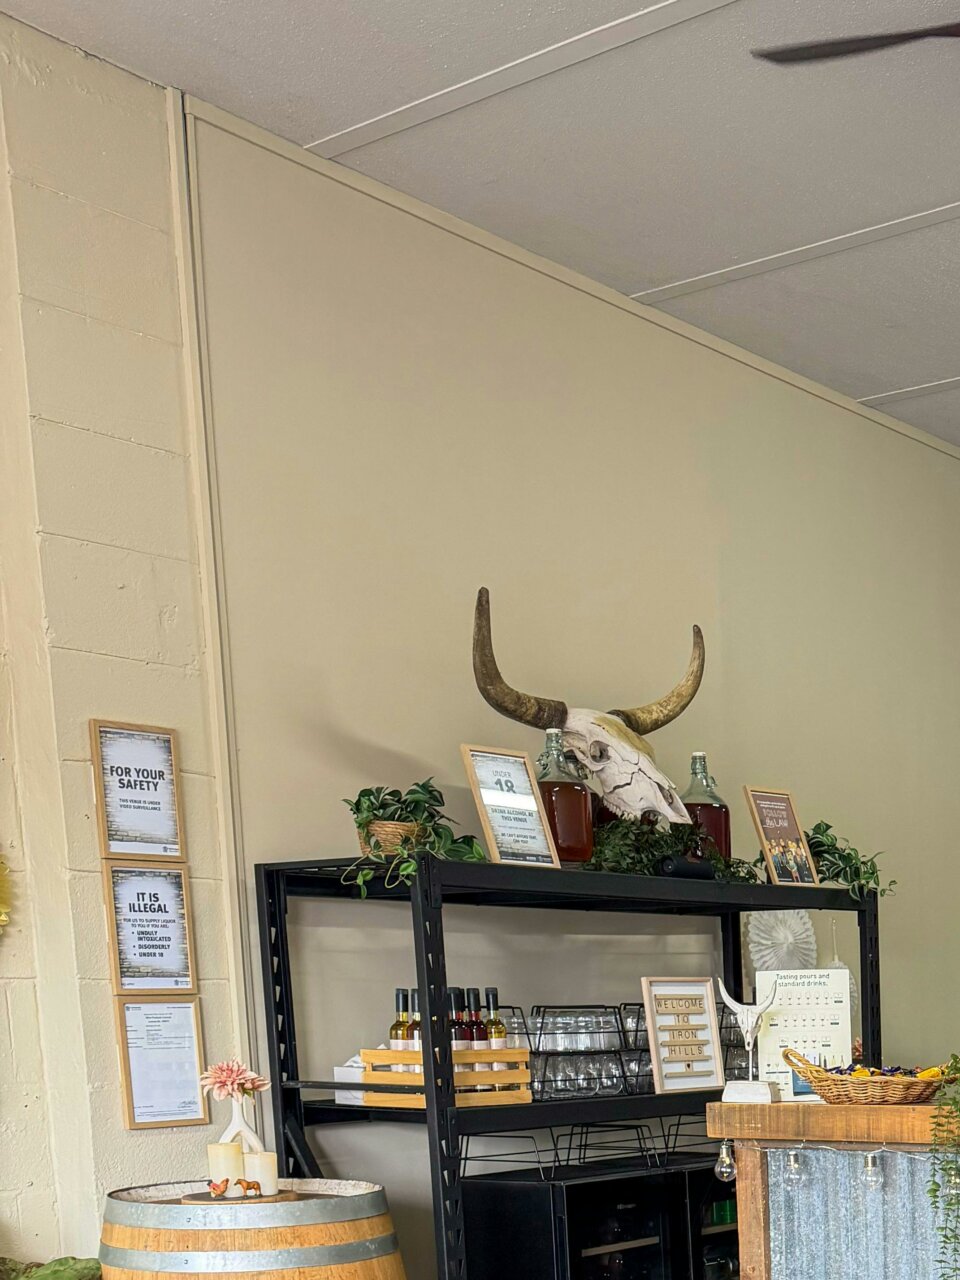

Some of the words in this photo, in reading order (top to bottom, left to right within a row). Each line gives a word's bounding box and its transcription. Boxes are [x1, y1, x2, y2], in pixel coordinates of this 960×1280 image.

[110, 766, 132, 778] FOR
[134, 768, 165, 780] YOUR
[118, 778, 159, 792] SAFETY
[137, 892, 146, 902] IT
[149, 893, 159, 902] IS
[129, 903, 169, 913] ILLEGAL
[657, 999, 703, 1009] WELCOME
[676, 1015, 688, 1023] TO
[672, 1031, 697, 1040] IRON
[670, 1046, 703, 1055] HILLS
